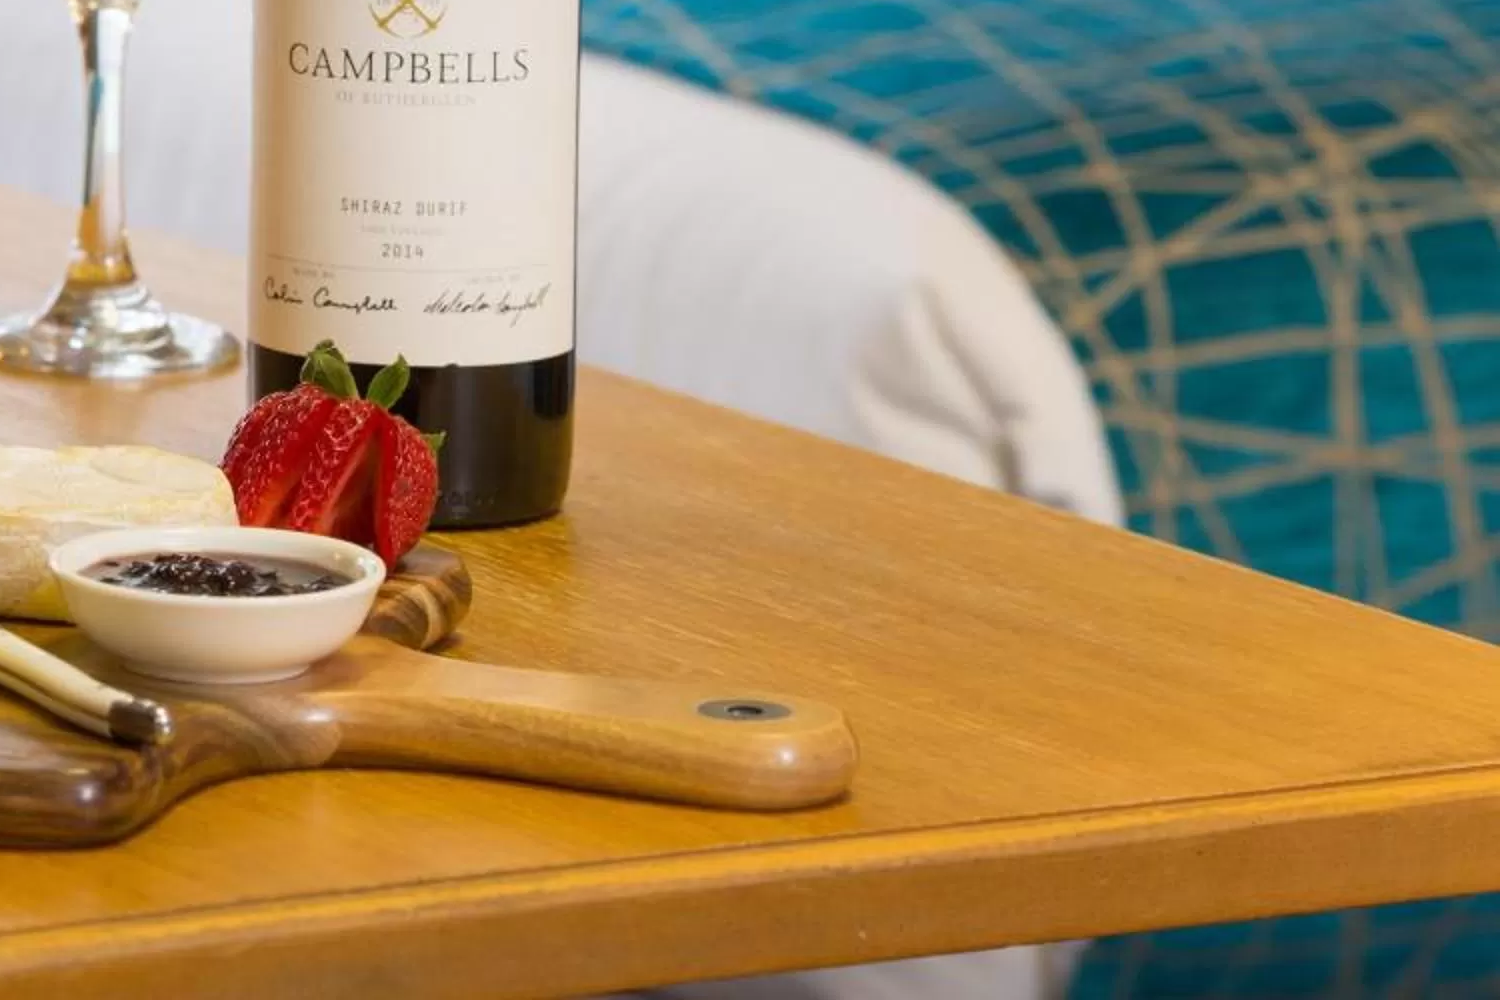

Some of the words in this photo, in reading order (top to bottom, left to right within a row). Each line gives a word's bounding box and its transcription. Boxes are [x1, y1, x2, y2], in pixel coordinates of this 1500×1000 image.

[288, 42, 530, 84] CAMPBELLS
[340, 197, 402, 216] SHIRAZ
[415, 200, 468, 217] DURIF
[381, 243, 424, 259] 2014
